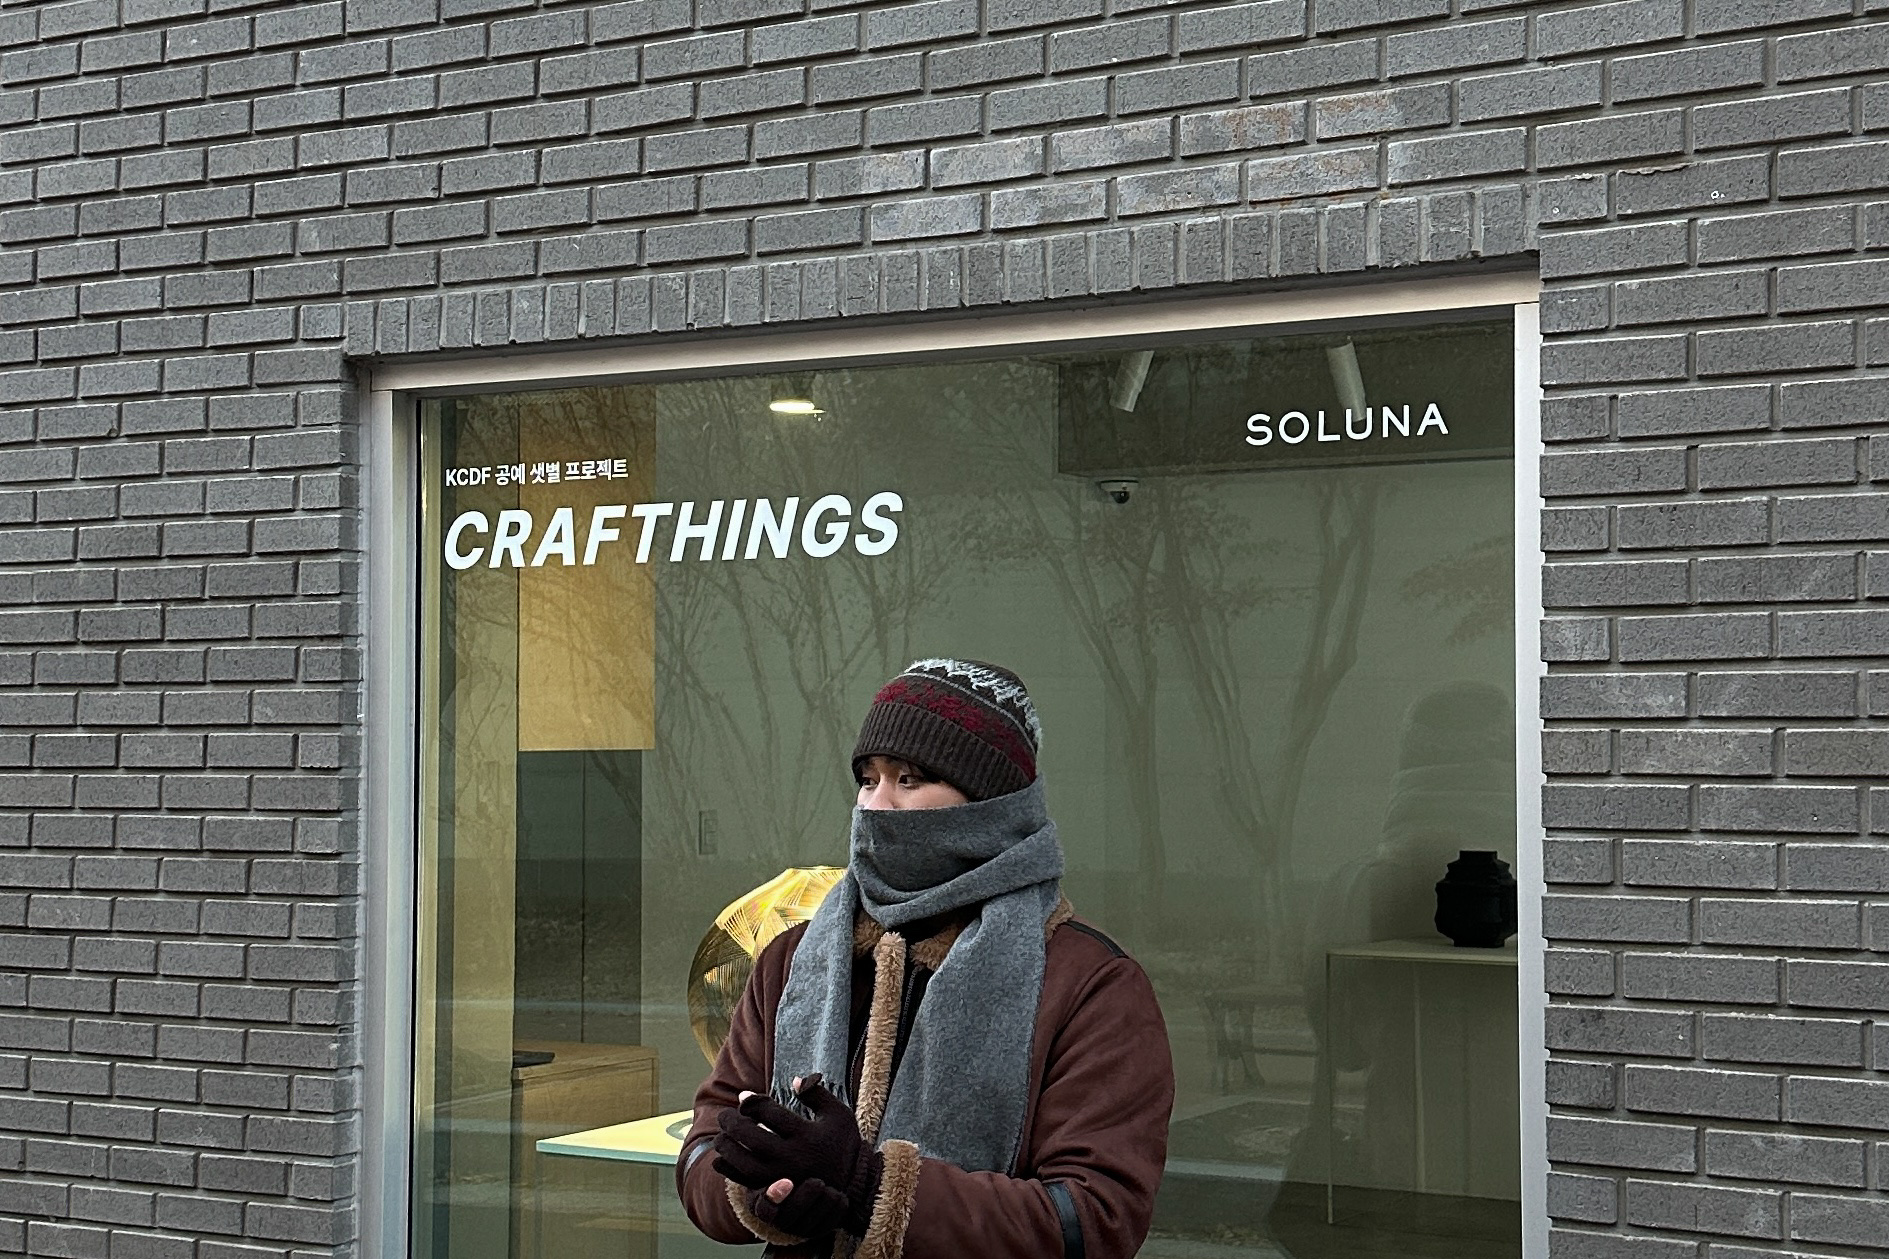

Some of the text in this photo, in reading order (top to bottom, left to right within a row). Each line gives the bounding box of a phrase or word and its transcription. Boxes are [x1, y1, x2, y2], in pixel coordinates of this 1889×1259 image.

[1245, 402, 1449, 446] SOLUNA
[445, 458, 629, 487] KCDF 공예 샛별 프로젝트
[444, 491, 904, 570] CRAFTHINGS
